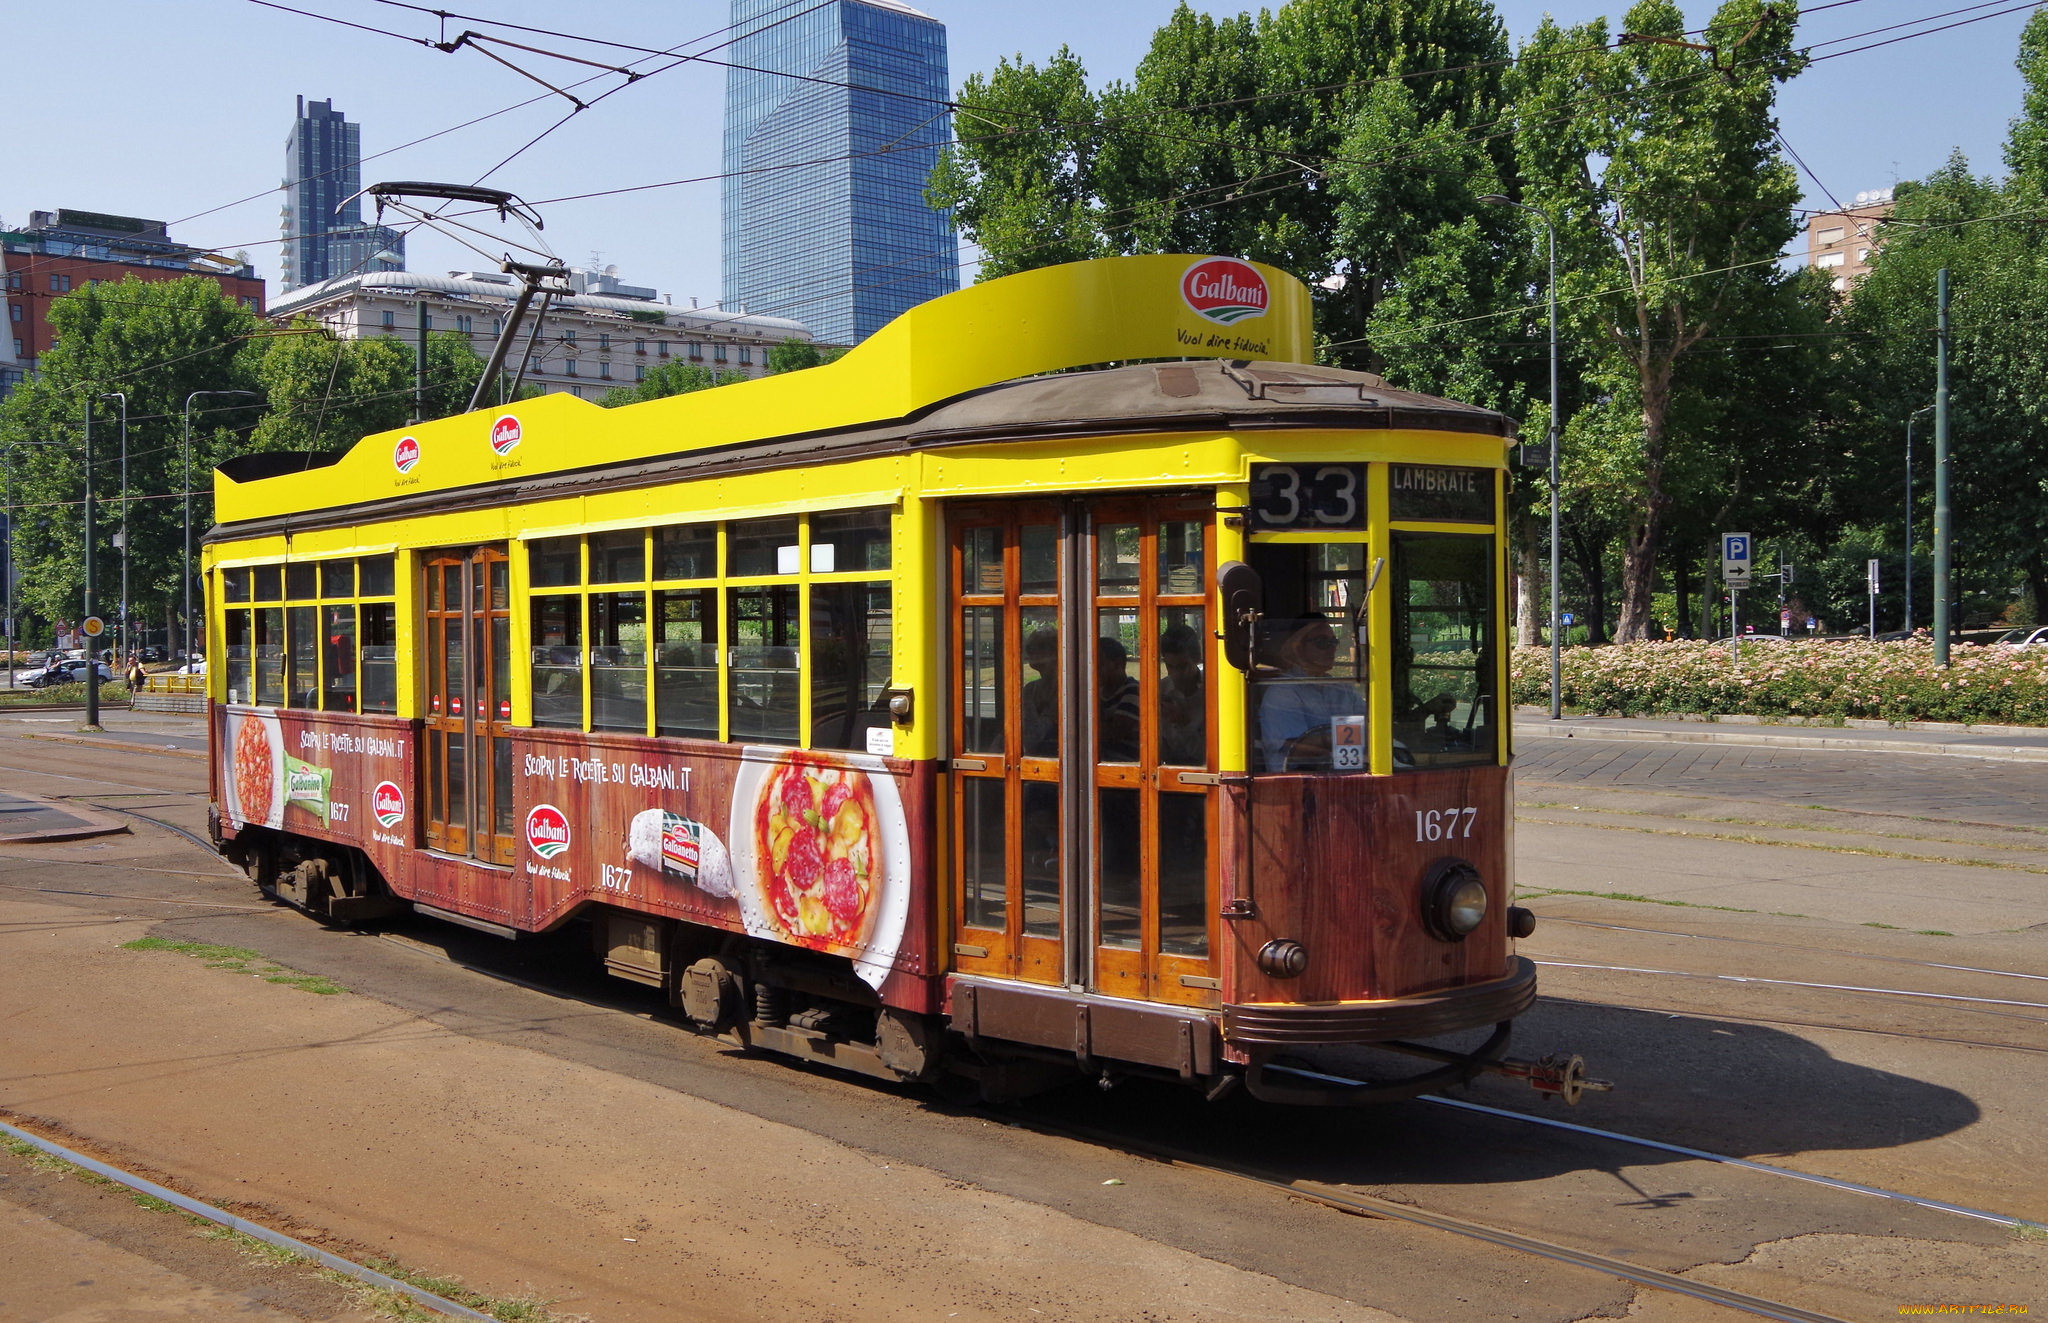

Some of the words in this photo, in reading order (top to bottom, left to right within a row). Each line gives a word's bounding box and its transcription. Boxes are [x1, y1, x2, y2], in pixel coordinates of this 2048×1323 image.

[1190, 272, 1262, 305] Galbani
[1177, 328, 1203, 345] Vuol
[1206, 334, 1231, 350] dire
[494, 425, 519, 444] Galbani
[396, 446, 418, 463] Galbani
[1394, 468, 1476, 492] LAMBRATE
[1258, 466, 1356, 524] 33
[1731, 542, 1744, 559] P
[90, 620, 98, 633] S
[300, 730, 320, 752] SCOPRI
[322, 732, 330, 749] LE
[330, 733, 354, 754] RICETTE
[354, 736, 364, 753] SU
[1344, 726, 1354, 744] 2
[1339, 748, 1360, 766] 33
[524, 754, 555, 780] SCOPRI
[558, 756, 569, 778] LE
[570, 757, 608, 784] RICETTE
[612, 763, 625, 784] SU
[330, 802, 349, 822] 1677
[376, 792, 402, 812] Galbani
[530, 817, 566, 842] Galbani
[1416, 806, 1478, 842] 1677
[663, 838, 698, 862] Galbanetto
[526, 860, 538, 874] Vuol
[538, 864, 551, 878] dire
[602, 863, 632, 892] 1677
